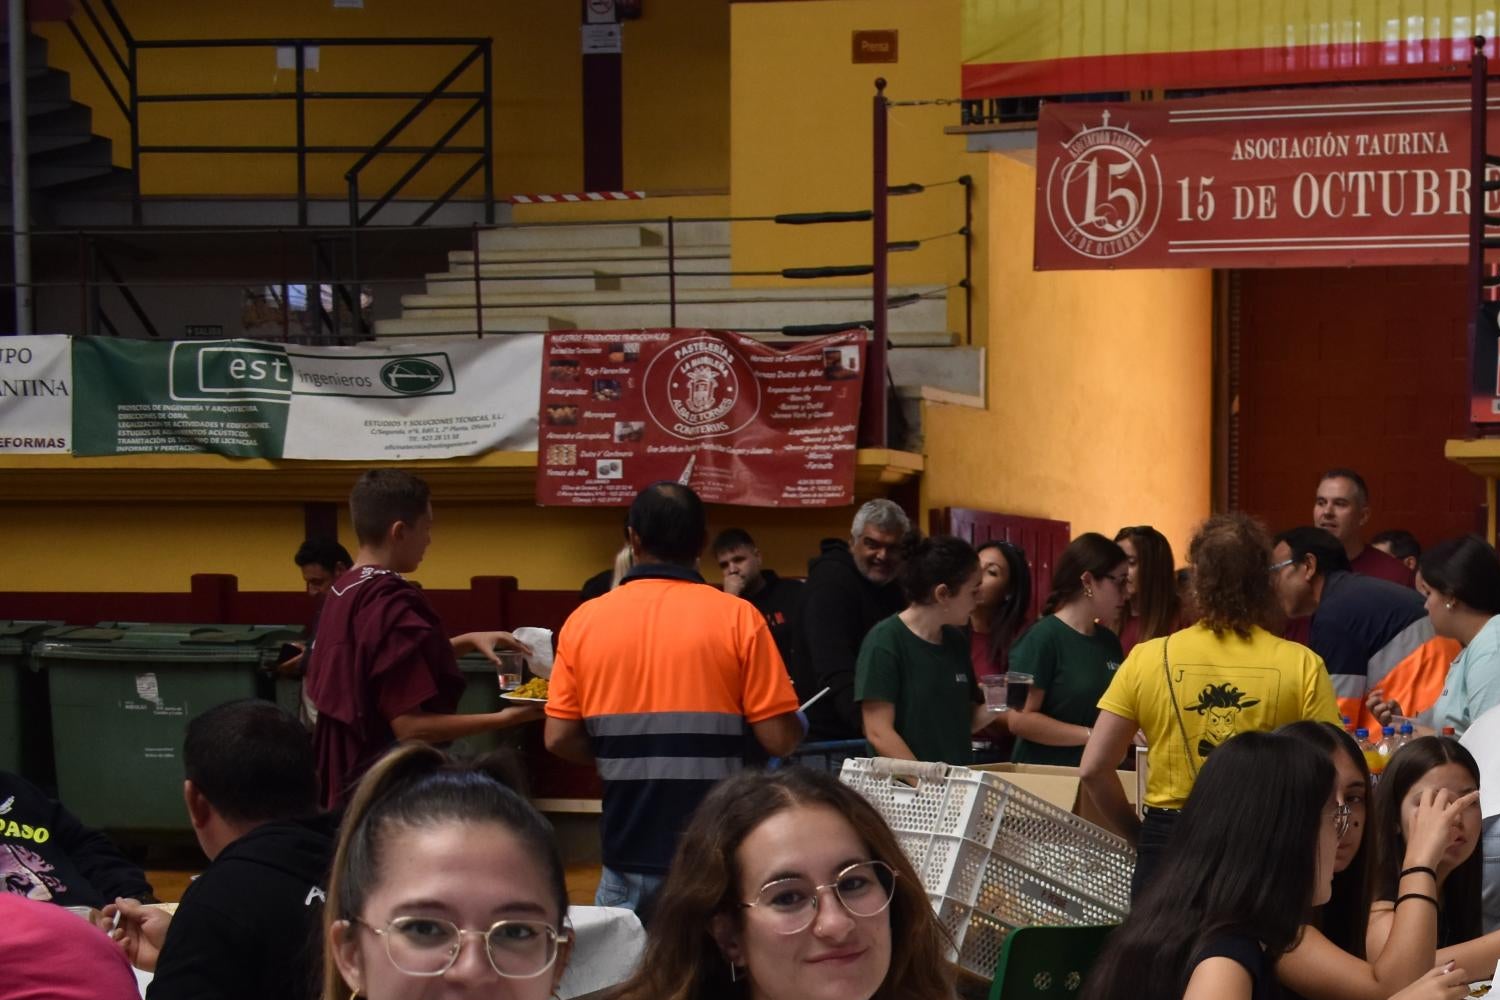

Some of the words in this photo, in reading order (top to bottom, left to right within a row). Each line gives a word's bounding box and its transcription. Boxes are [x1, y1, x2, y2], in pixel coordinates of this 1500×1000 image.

[861, 39, 889, 52] Prensa
[1231, 131, 1350, 161] ASOCIACIÓN
[1355, 131, 1449, 156] TAURINA
[1061, 157, 1140, 233] 15
[1176, 176, 1216, 222] 15
[1232, 185, 1277, 220] DE
[0, 347, 33, 364] PO
[229, 357, 288, 383] est
[300, 368, 373, 388] ingenieros
[0, 379, 70, 396] NTINA
